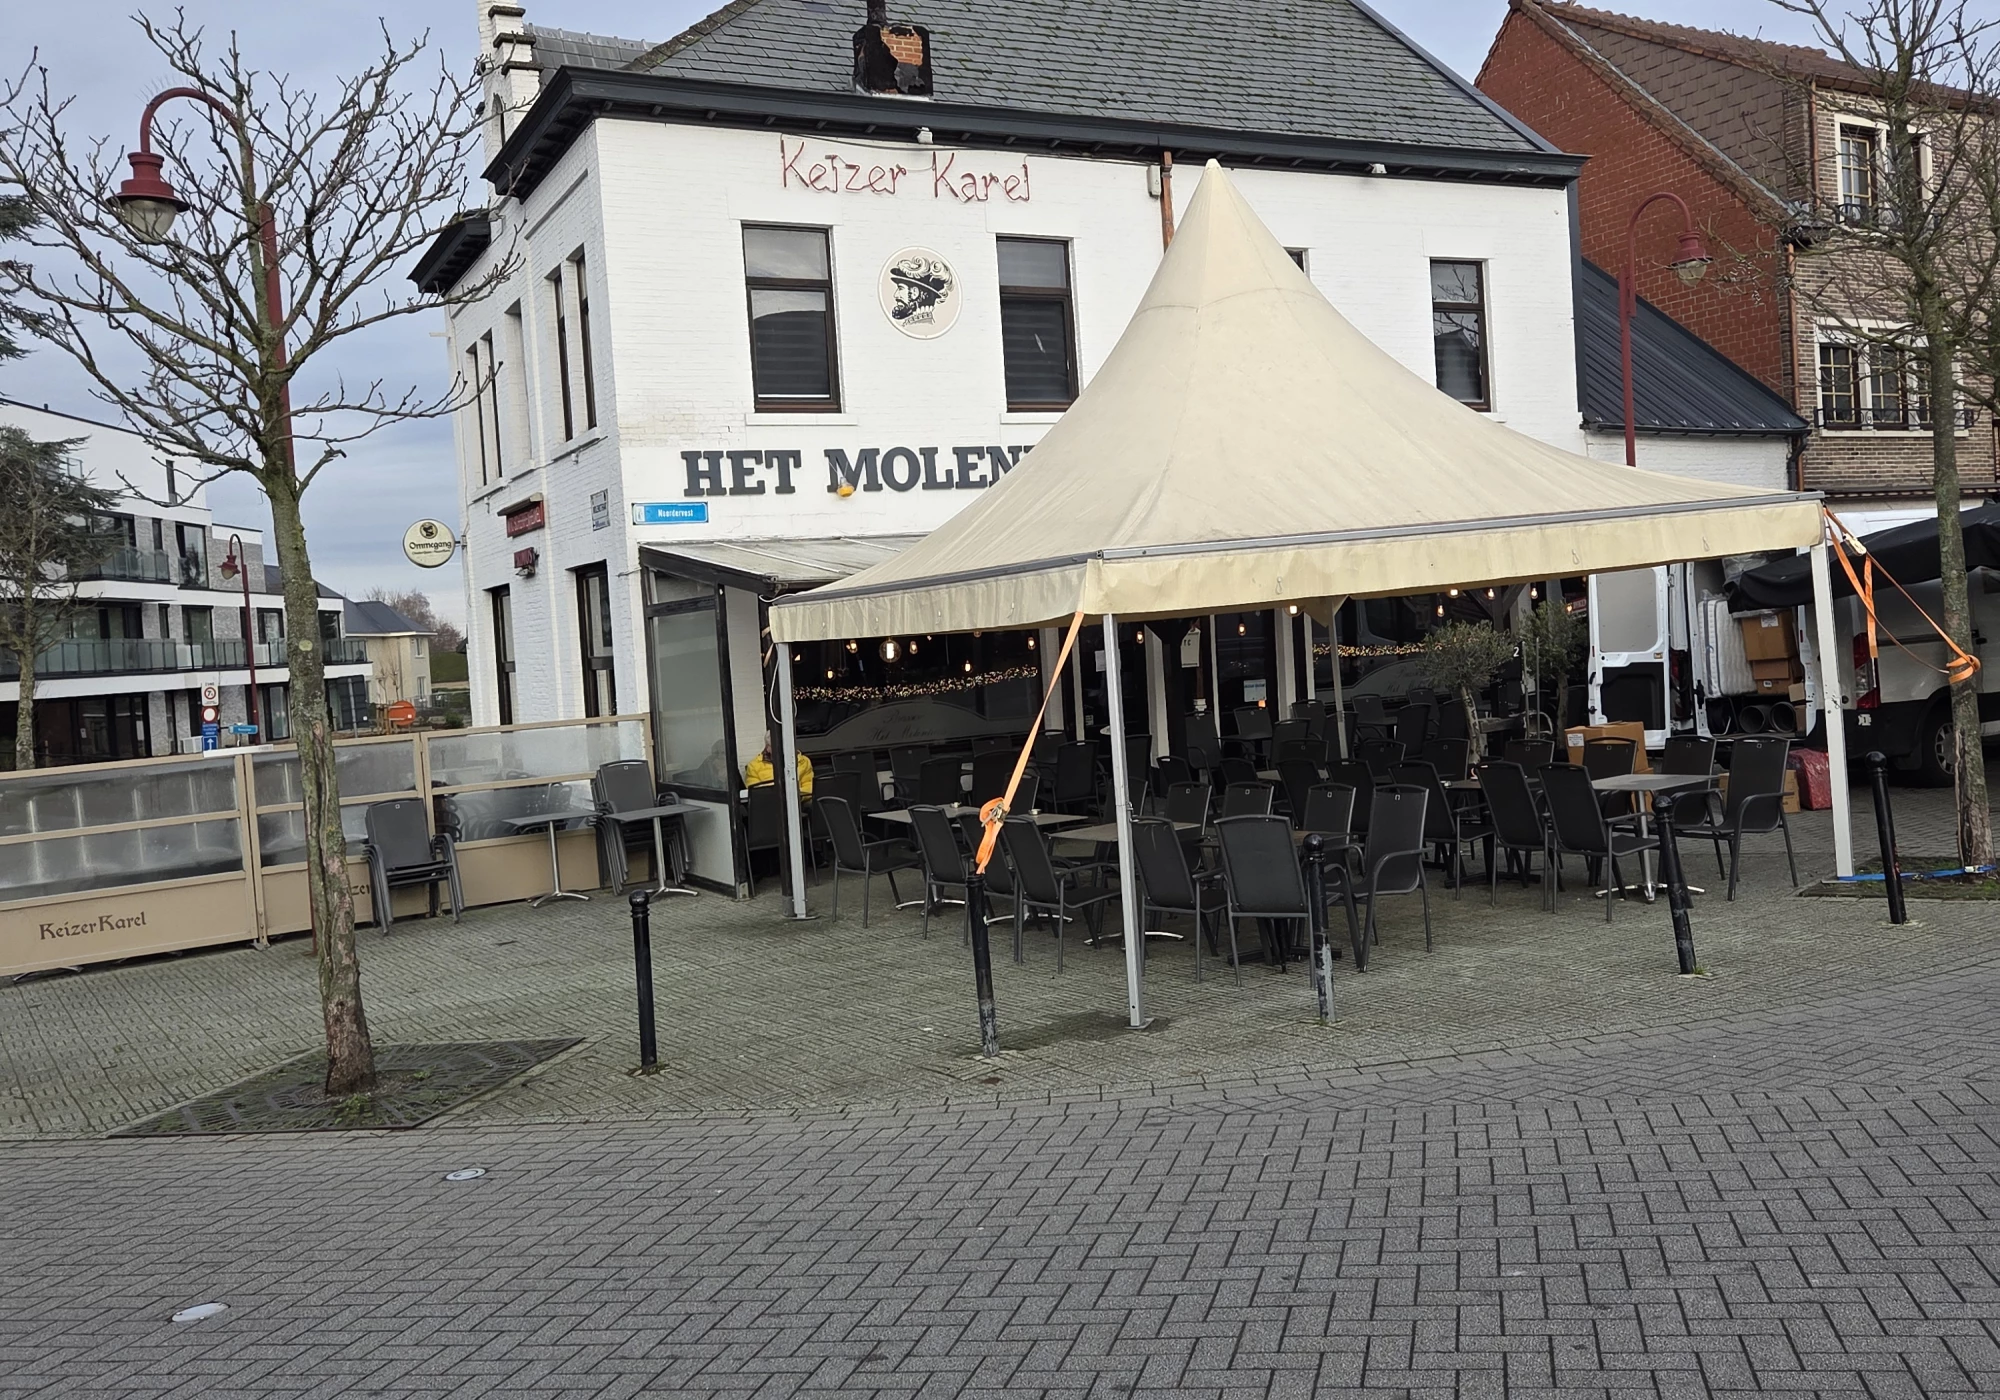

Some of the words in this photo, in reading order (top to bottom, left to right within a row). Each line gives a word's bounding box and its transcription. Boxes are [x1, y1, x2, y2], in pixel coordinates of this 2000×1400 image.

[932, 151, 1030, 203] Karel
[680, 449, 802, 497] HET
[823, 446, 1036, 492] MOLEN
[408, 541, 452, 550] Ommegang
[1513, 646, 1520, 658] 2
